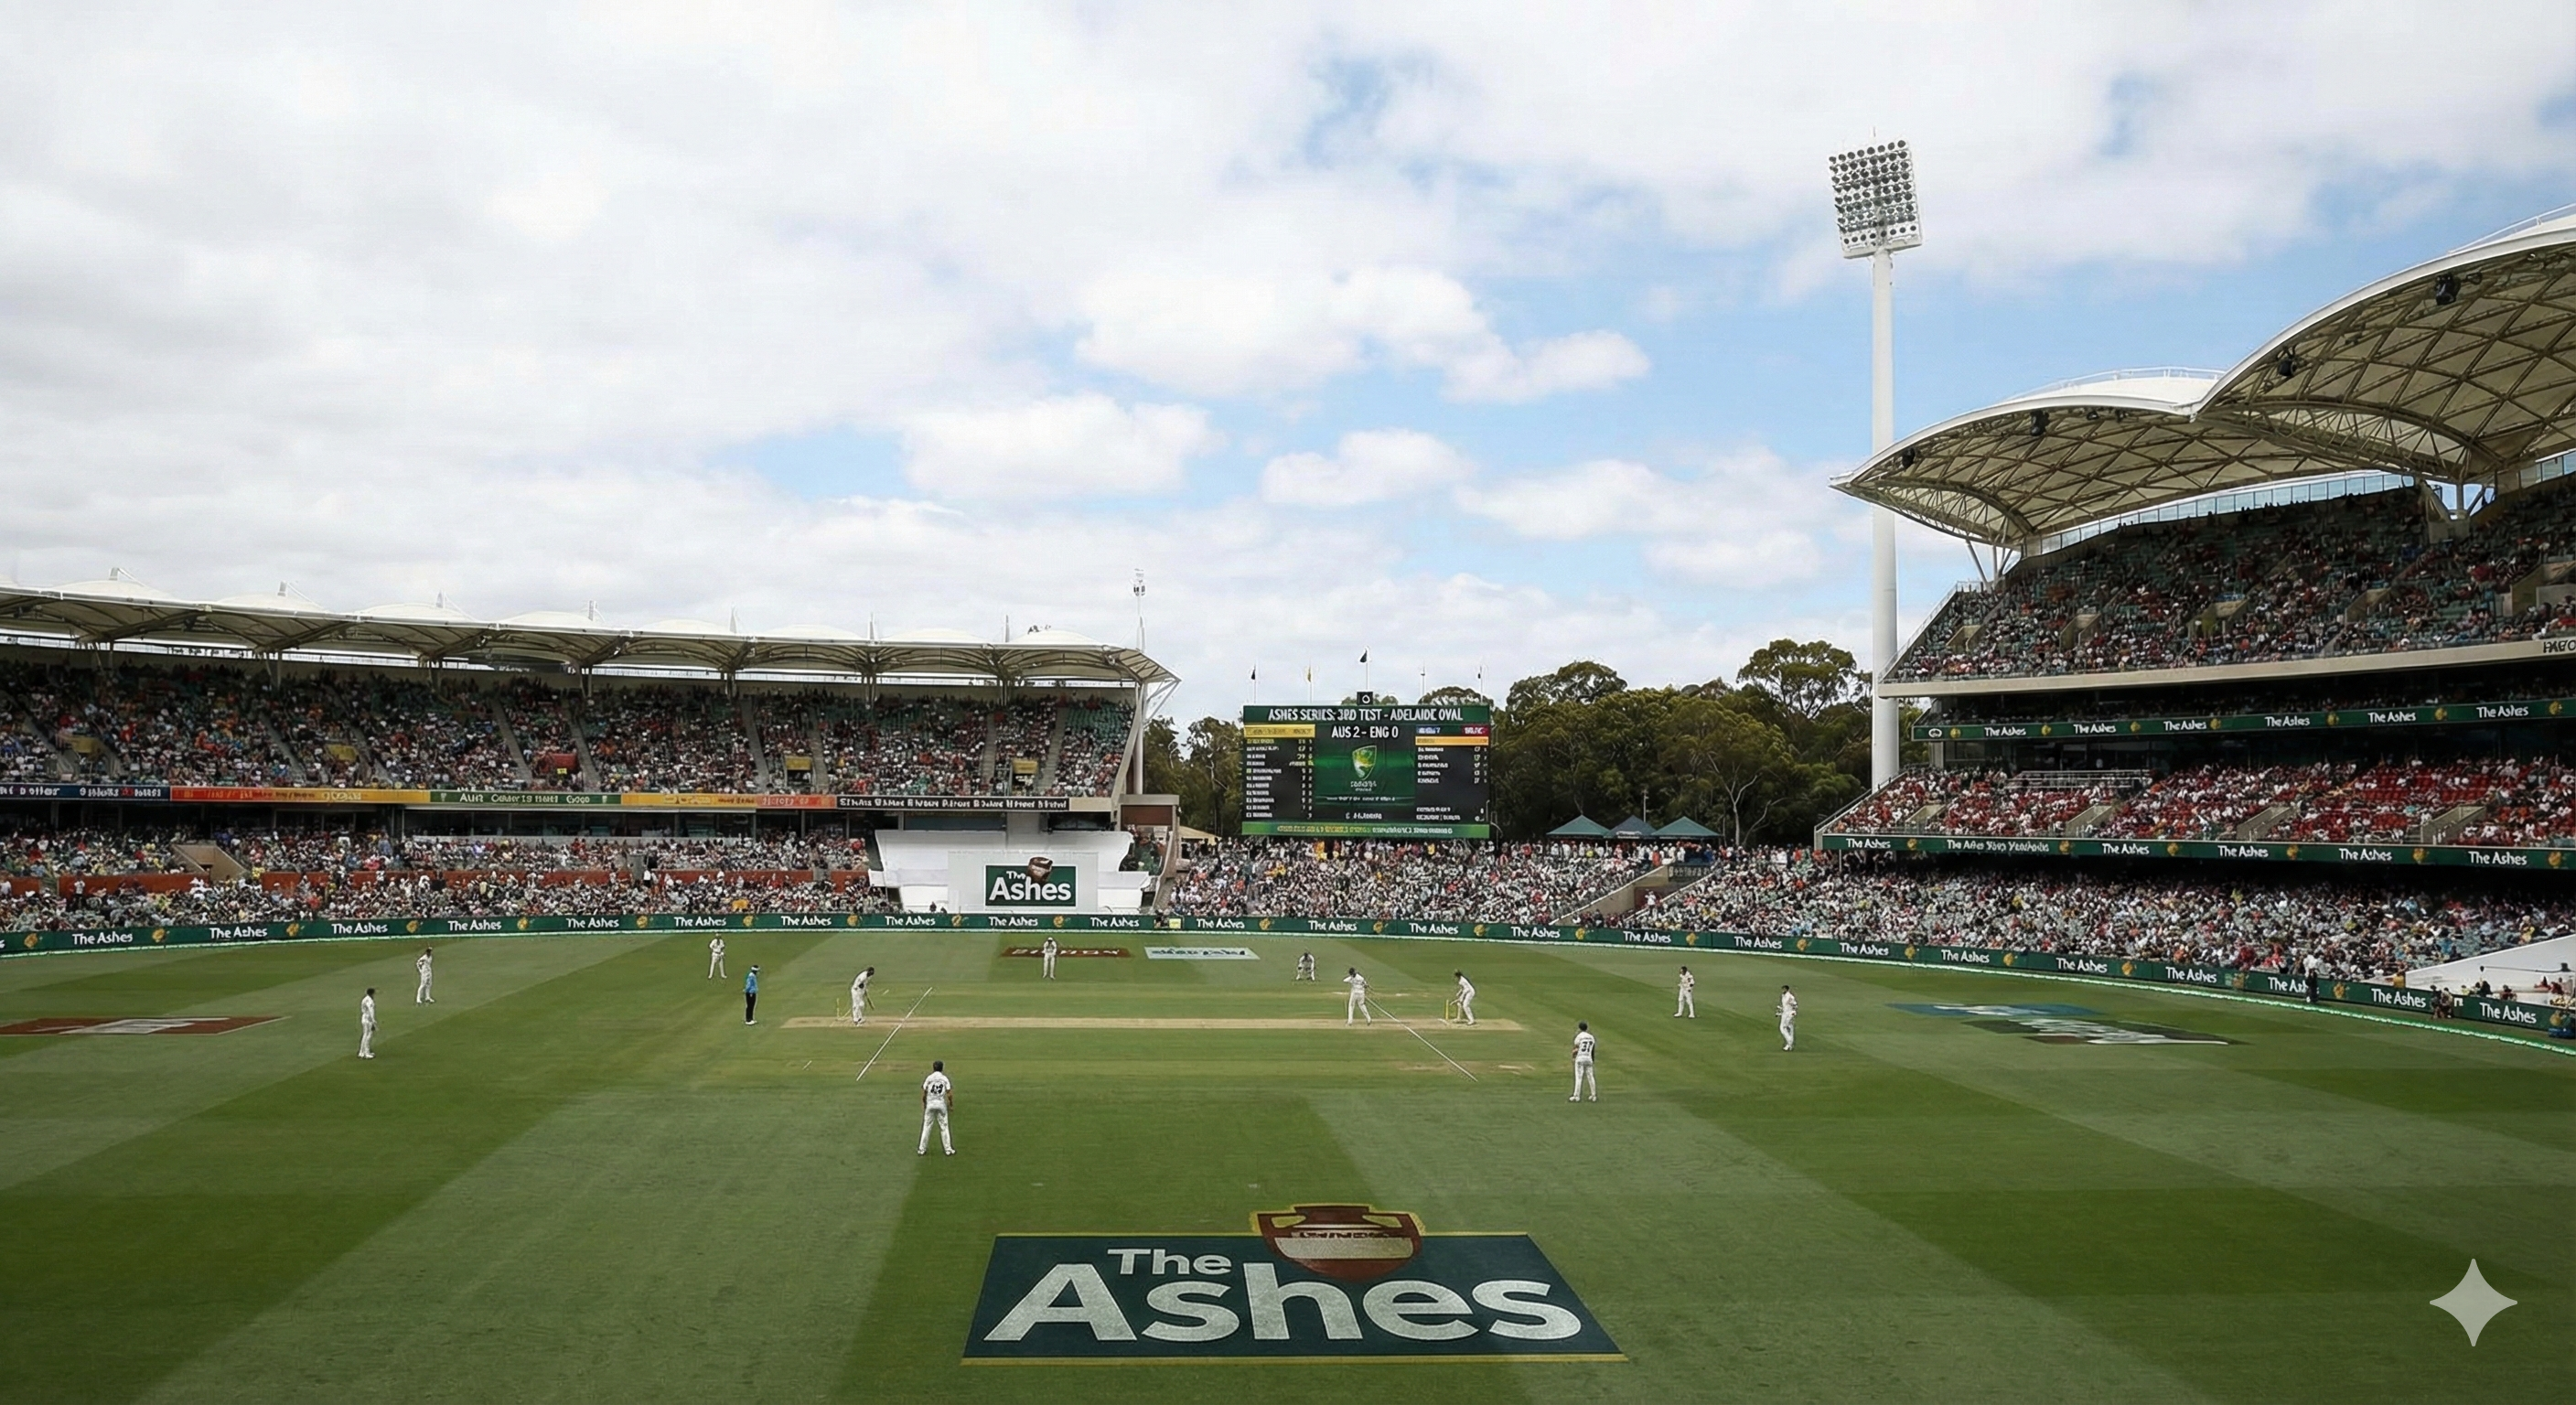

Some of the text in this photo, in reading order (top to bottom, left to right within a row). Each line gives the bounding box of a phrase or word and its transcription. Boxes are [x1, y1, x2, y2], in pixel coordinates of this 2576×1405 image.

[1268, 708, 1298, 721] ASHES
[1337, 709, 1357, 721] 3RD
[1358, 709, 1382, 721] TEST
[1390, 708, 1437, 721] ADELAIDE
[1438, 708, 1464, 721] OVAL
[1331, 725, 1351, 738] AUS
[1353, 725, 1360, 738] 2
[1369, 725, 1390, 738] ENG
[1846, 838, 1891, 849] The Ashes
[2101, 843, 2150, 854] The Ashes
[2217, 845, 2269, 857] The Ashes
[2338, 848, 2392, 861] The Ashes
[2468, 851, 2528, 865] The Ashes
[989, 876, 1072, 901] Ashes
[447, 919, 501, 930] The Ashes
[565, 917, 619, 928] The Ashes
[673, 916, 726, 927] The Ashes
[780, 916, 832, 926] The Ashes
[885, 916, 936, 926] The Ashes
[988, 917, 1038, 927] The Ashes
[1089, 917, 1140, 927] The Ashes
[1197, 918, 1214, 928] The
[1307, 920, 1358, 931] The Ashes
[209, 926, 268, 938] The Ashes
[331, 922, 388, 934] The Ashes
[1409, 922, 1459, 934] The Ashes
[1510, 927, 1561, 938] The Ashes
[72, 931, 133, 945] The Ashes
[1623, 931, 1641, 941] The
[1733, 936, 1782, 949] The Ashes
[1840, 942, 1889, 956] The Ashes
[1941, 949, 1990, 963] The Ashes
[2055, 957, 2108, 973] The Ashes
[2165, 966, 2216, 983] The Ashes
[2268, 976, 2288, 992] The
[2371, 988, 2426, 1008] The Ashes
[2479, 1002, 2537, 1024] The Ashes
[1106, 1247, 1232, 1276] The
[982, 1262, 1582, 1343] Ashes
